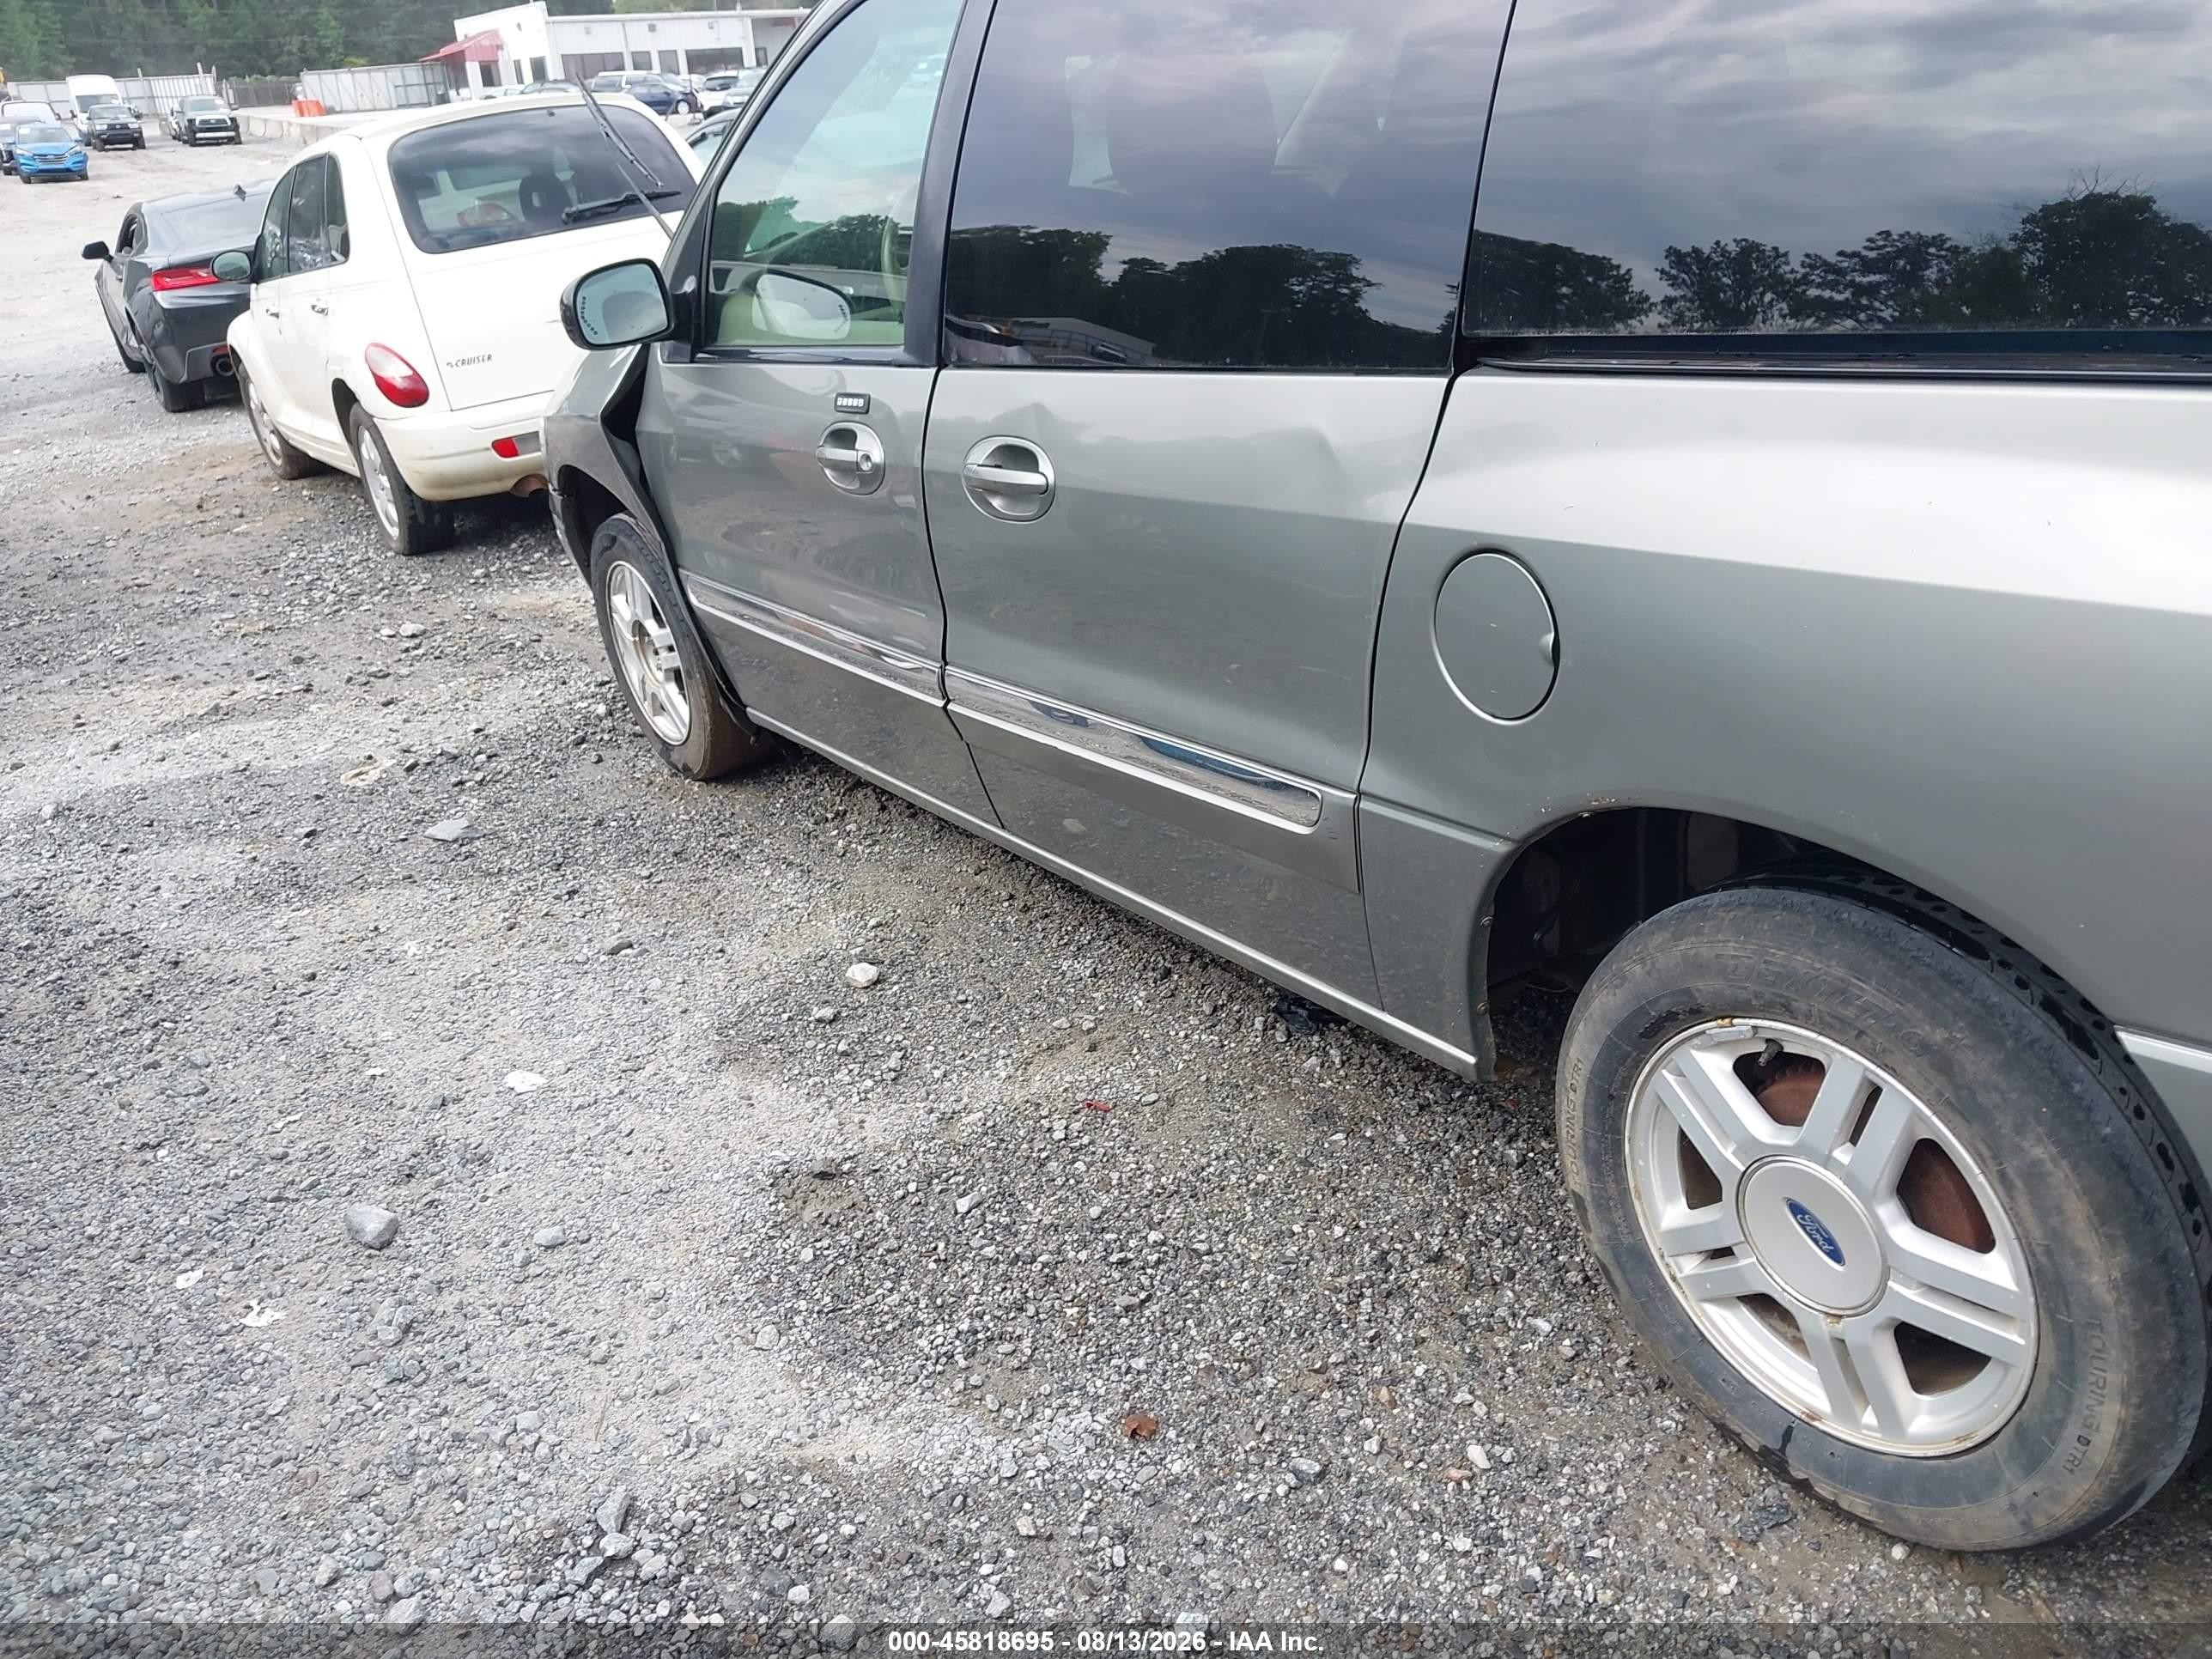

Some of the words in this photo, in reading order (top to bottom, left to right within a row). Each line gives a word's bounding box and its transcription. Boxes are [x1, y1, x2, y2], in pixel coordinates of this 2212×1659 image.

[455, 354, 493, 368] CRUISER
[1565, 1097, 1582, 1187] TOURING
[1796, 1214, 1834, 1253] Ford
[2082, 1318, 2107, 1433] TOURING
